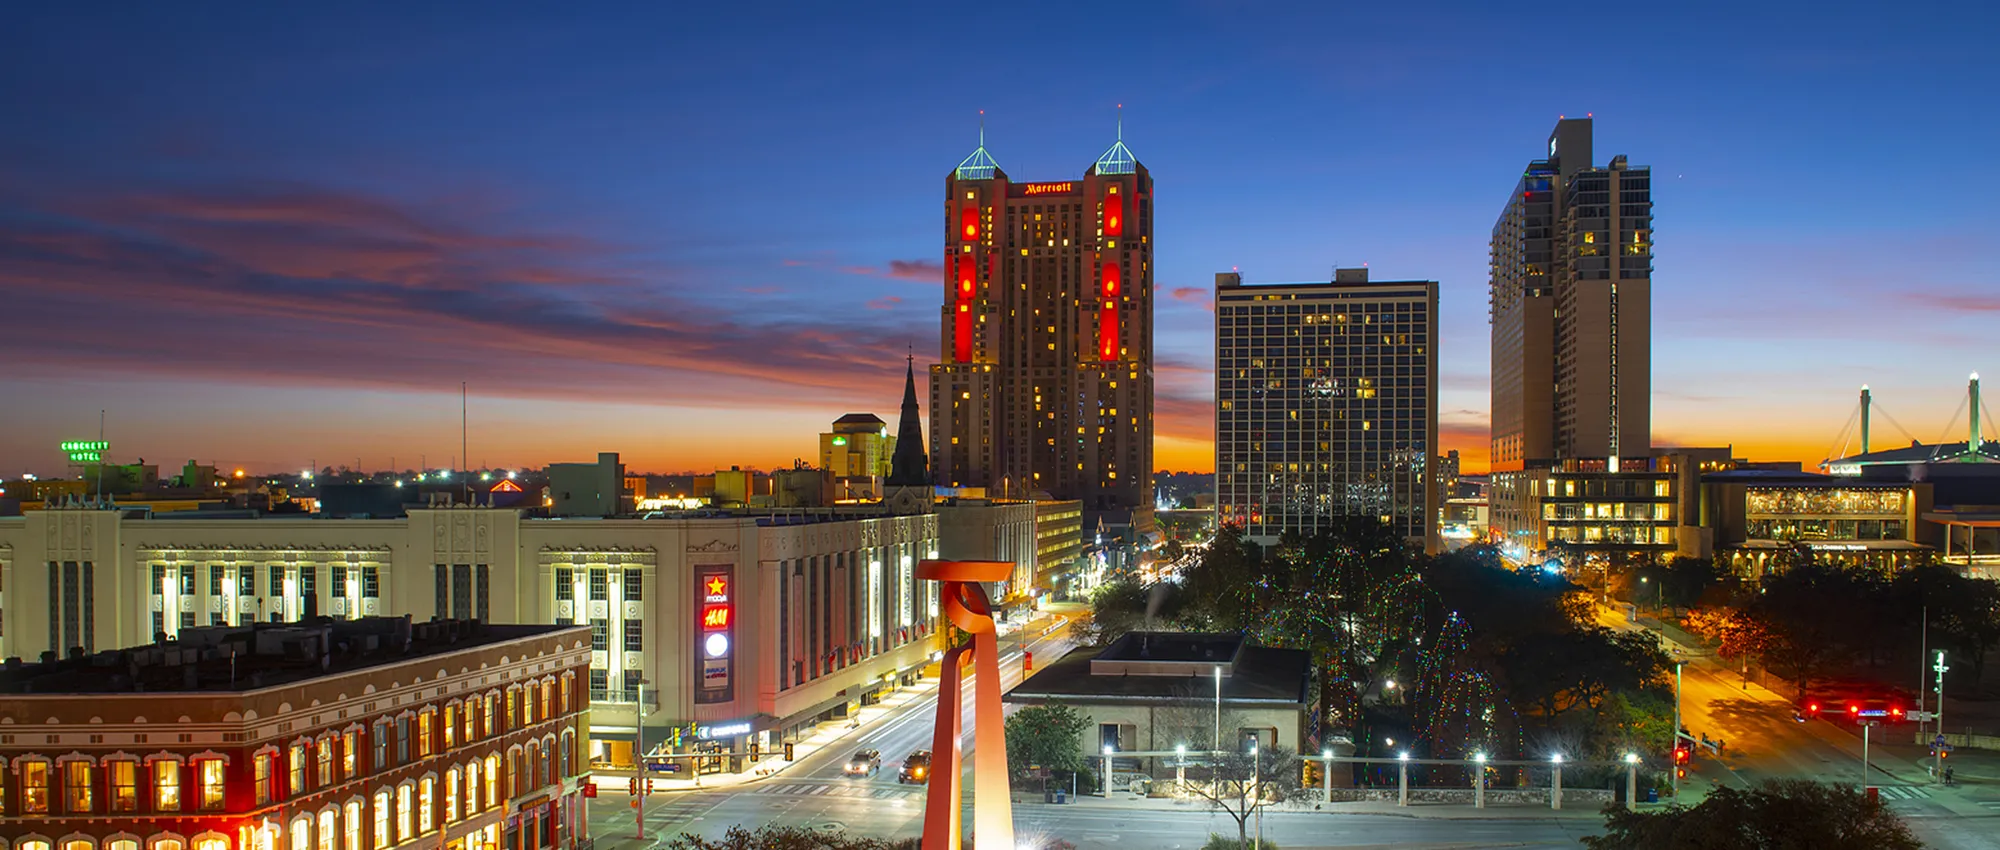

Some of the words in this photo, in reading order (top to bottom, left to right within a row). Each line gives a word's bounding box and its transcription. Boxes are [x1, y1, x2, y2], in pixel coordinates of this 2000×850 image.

[1024, 183, 1072, 195] Marriott
[61, 441, 109, 451] CROCKETT
[70, 452, 101, 461] HOTEL
